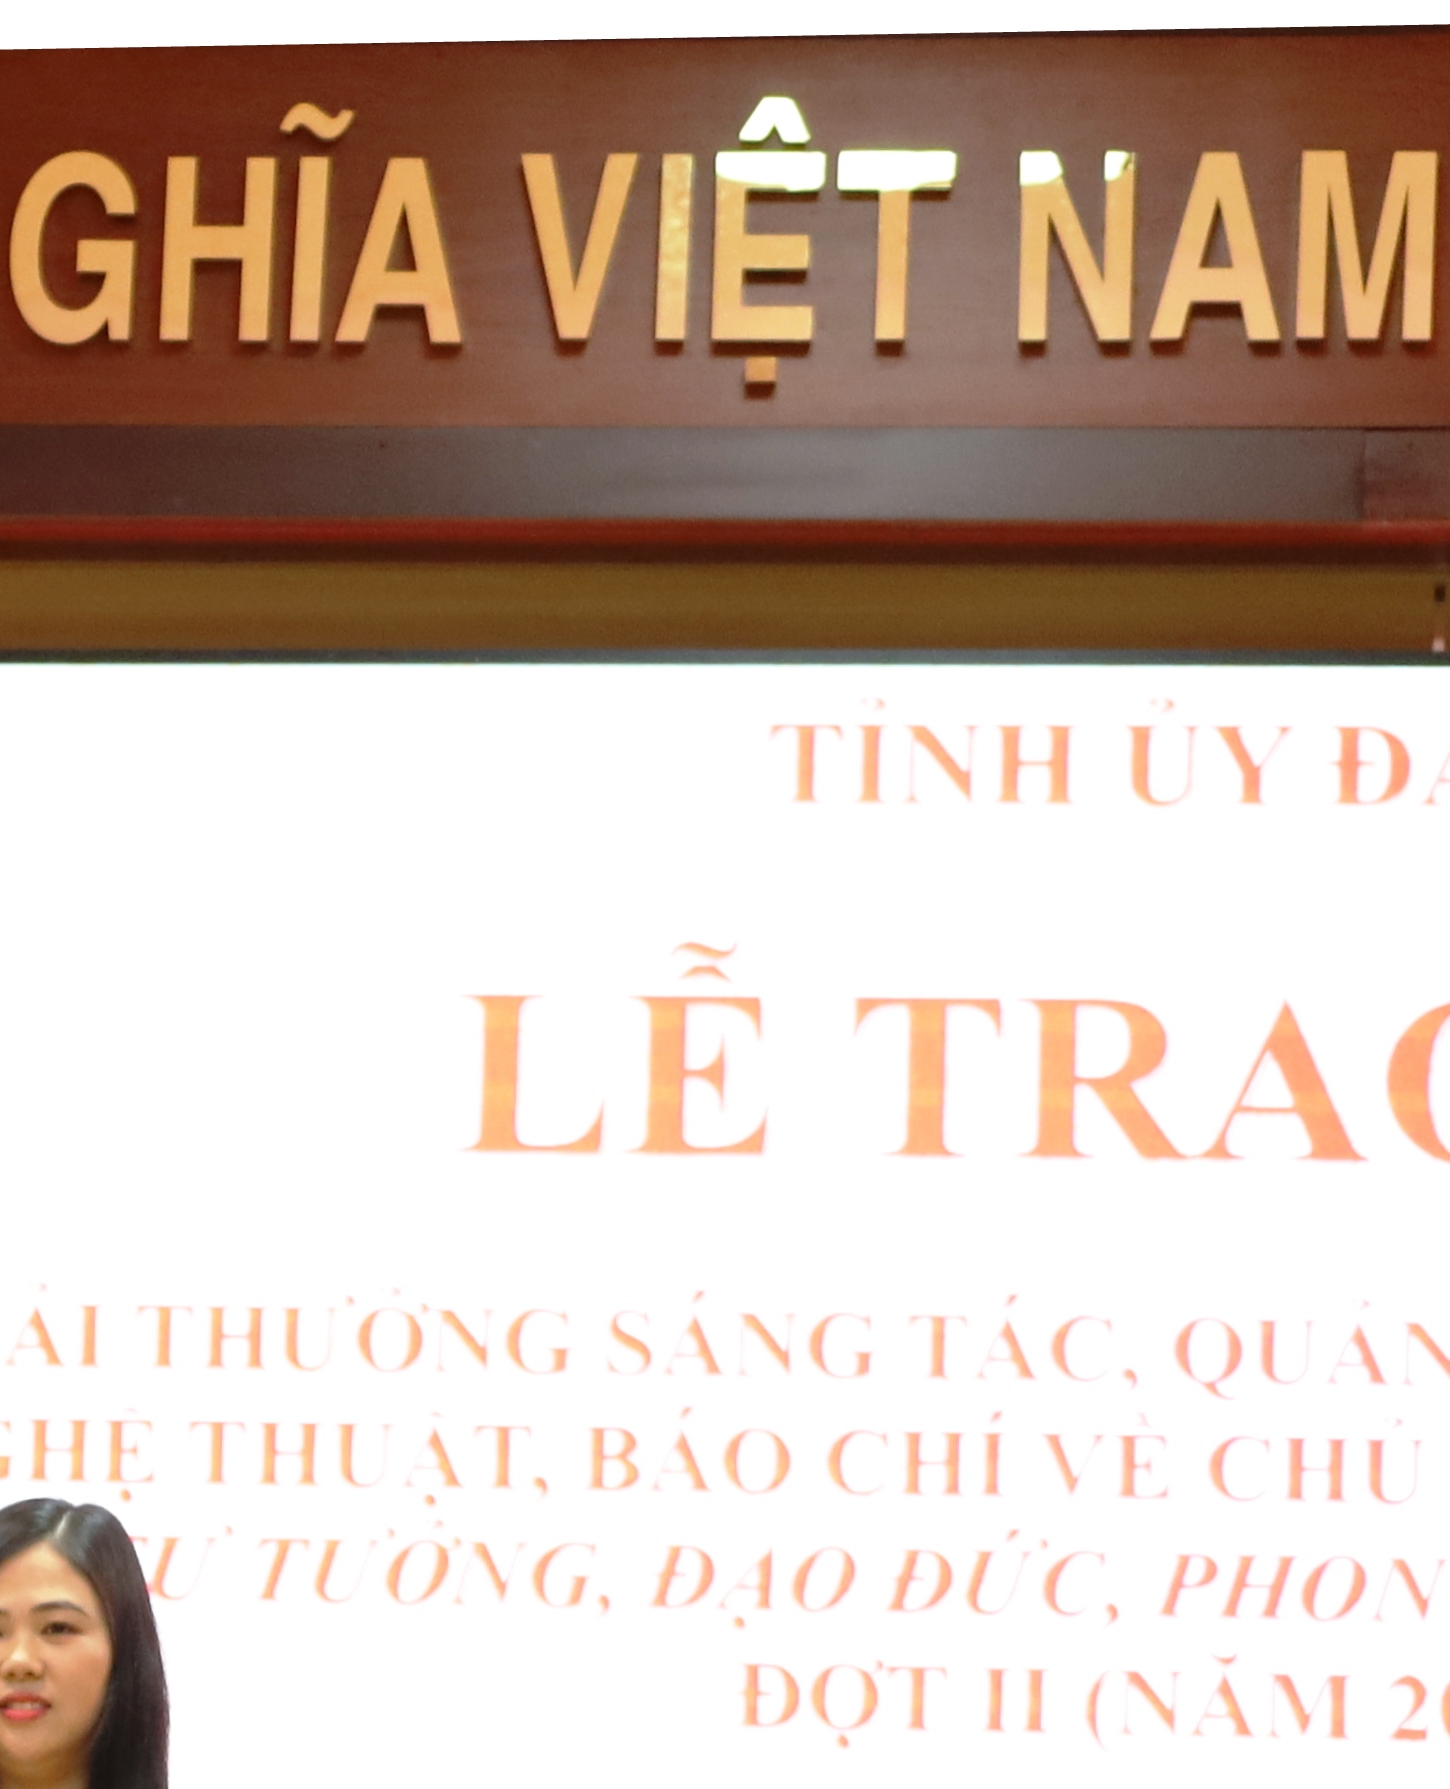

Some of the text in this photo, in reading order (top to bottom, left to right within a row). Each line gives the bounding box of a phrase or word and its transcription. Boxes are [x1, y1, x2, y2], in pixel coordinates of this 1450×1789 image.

[519, 95, 958, 392] VIỆT
[1018, 147, 1441, 346] NAM
[771, 696, 1070, 804] TỈNH
[1129, 697, 1289, 806] ỦY
[469, 942, 766, 1155] LỄ
[139, 1290, 567, 1372] THƯỞNG
[609, 1291, 871, 1376] SÁNG
[912, 1295, 1137, 1384] TÁC,
[191, 1415, 547, 1506] THUẬT,
[590, 1408, 791, 1491] BÁO
[828, 1412, 1001, 1495] CHÍ
[1046, 1413, 1167, 1497] VỀ
[1209, 1418, 1421, 1503] CHỦ
[258, 1522, 610, 1611] TƯỞNG,
[652, 1546, 856, 1628] ĐẠO
[889, 1530, 1118, 1621] ĐỨC,
[743, 1662, 945, 1748] ĐỢT
[987, 1669, 1043, 1732] II
[1086, 1657, 1347, 1739] (NĂM
